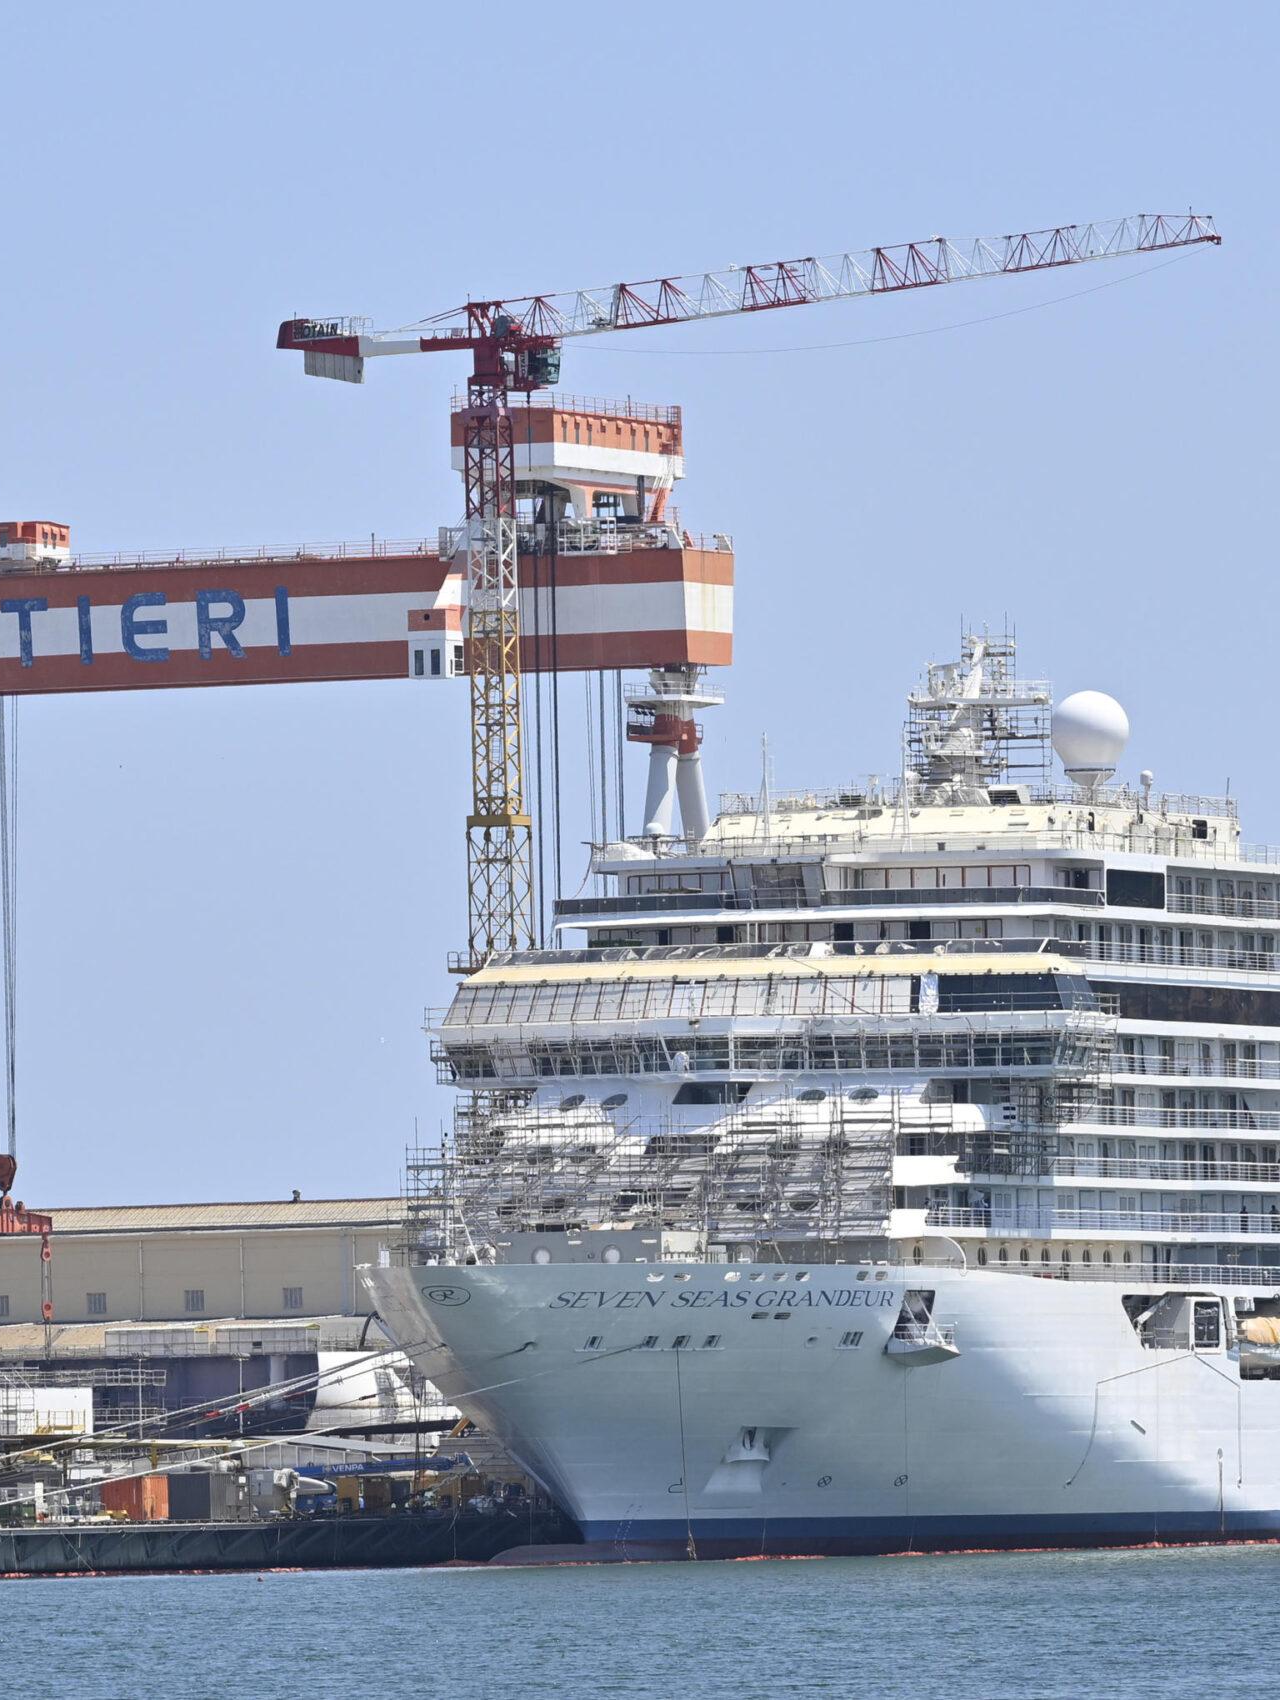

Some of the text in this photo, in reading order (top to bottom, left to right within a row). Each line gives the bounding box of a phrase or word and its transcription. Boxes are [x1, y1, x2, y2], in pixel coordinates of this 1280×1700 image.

[548, 1289, 895, 1309] SEVEN SEAS GRANDEUR
[331, 1462, 365, 1473] VENPA
